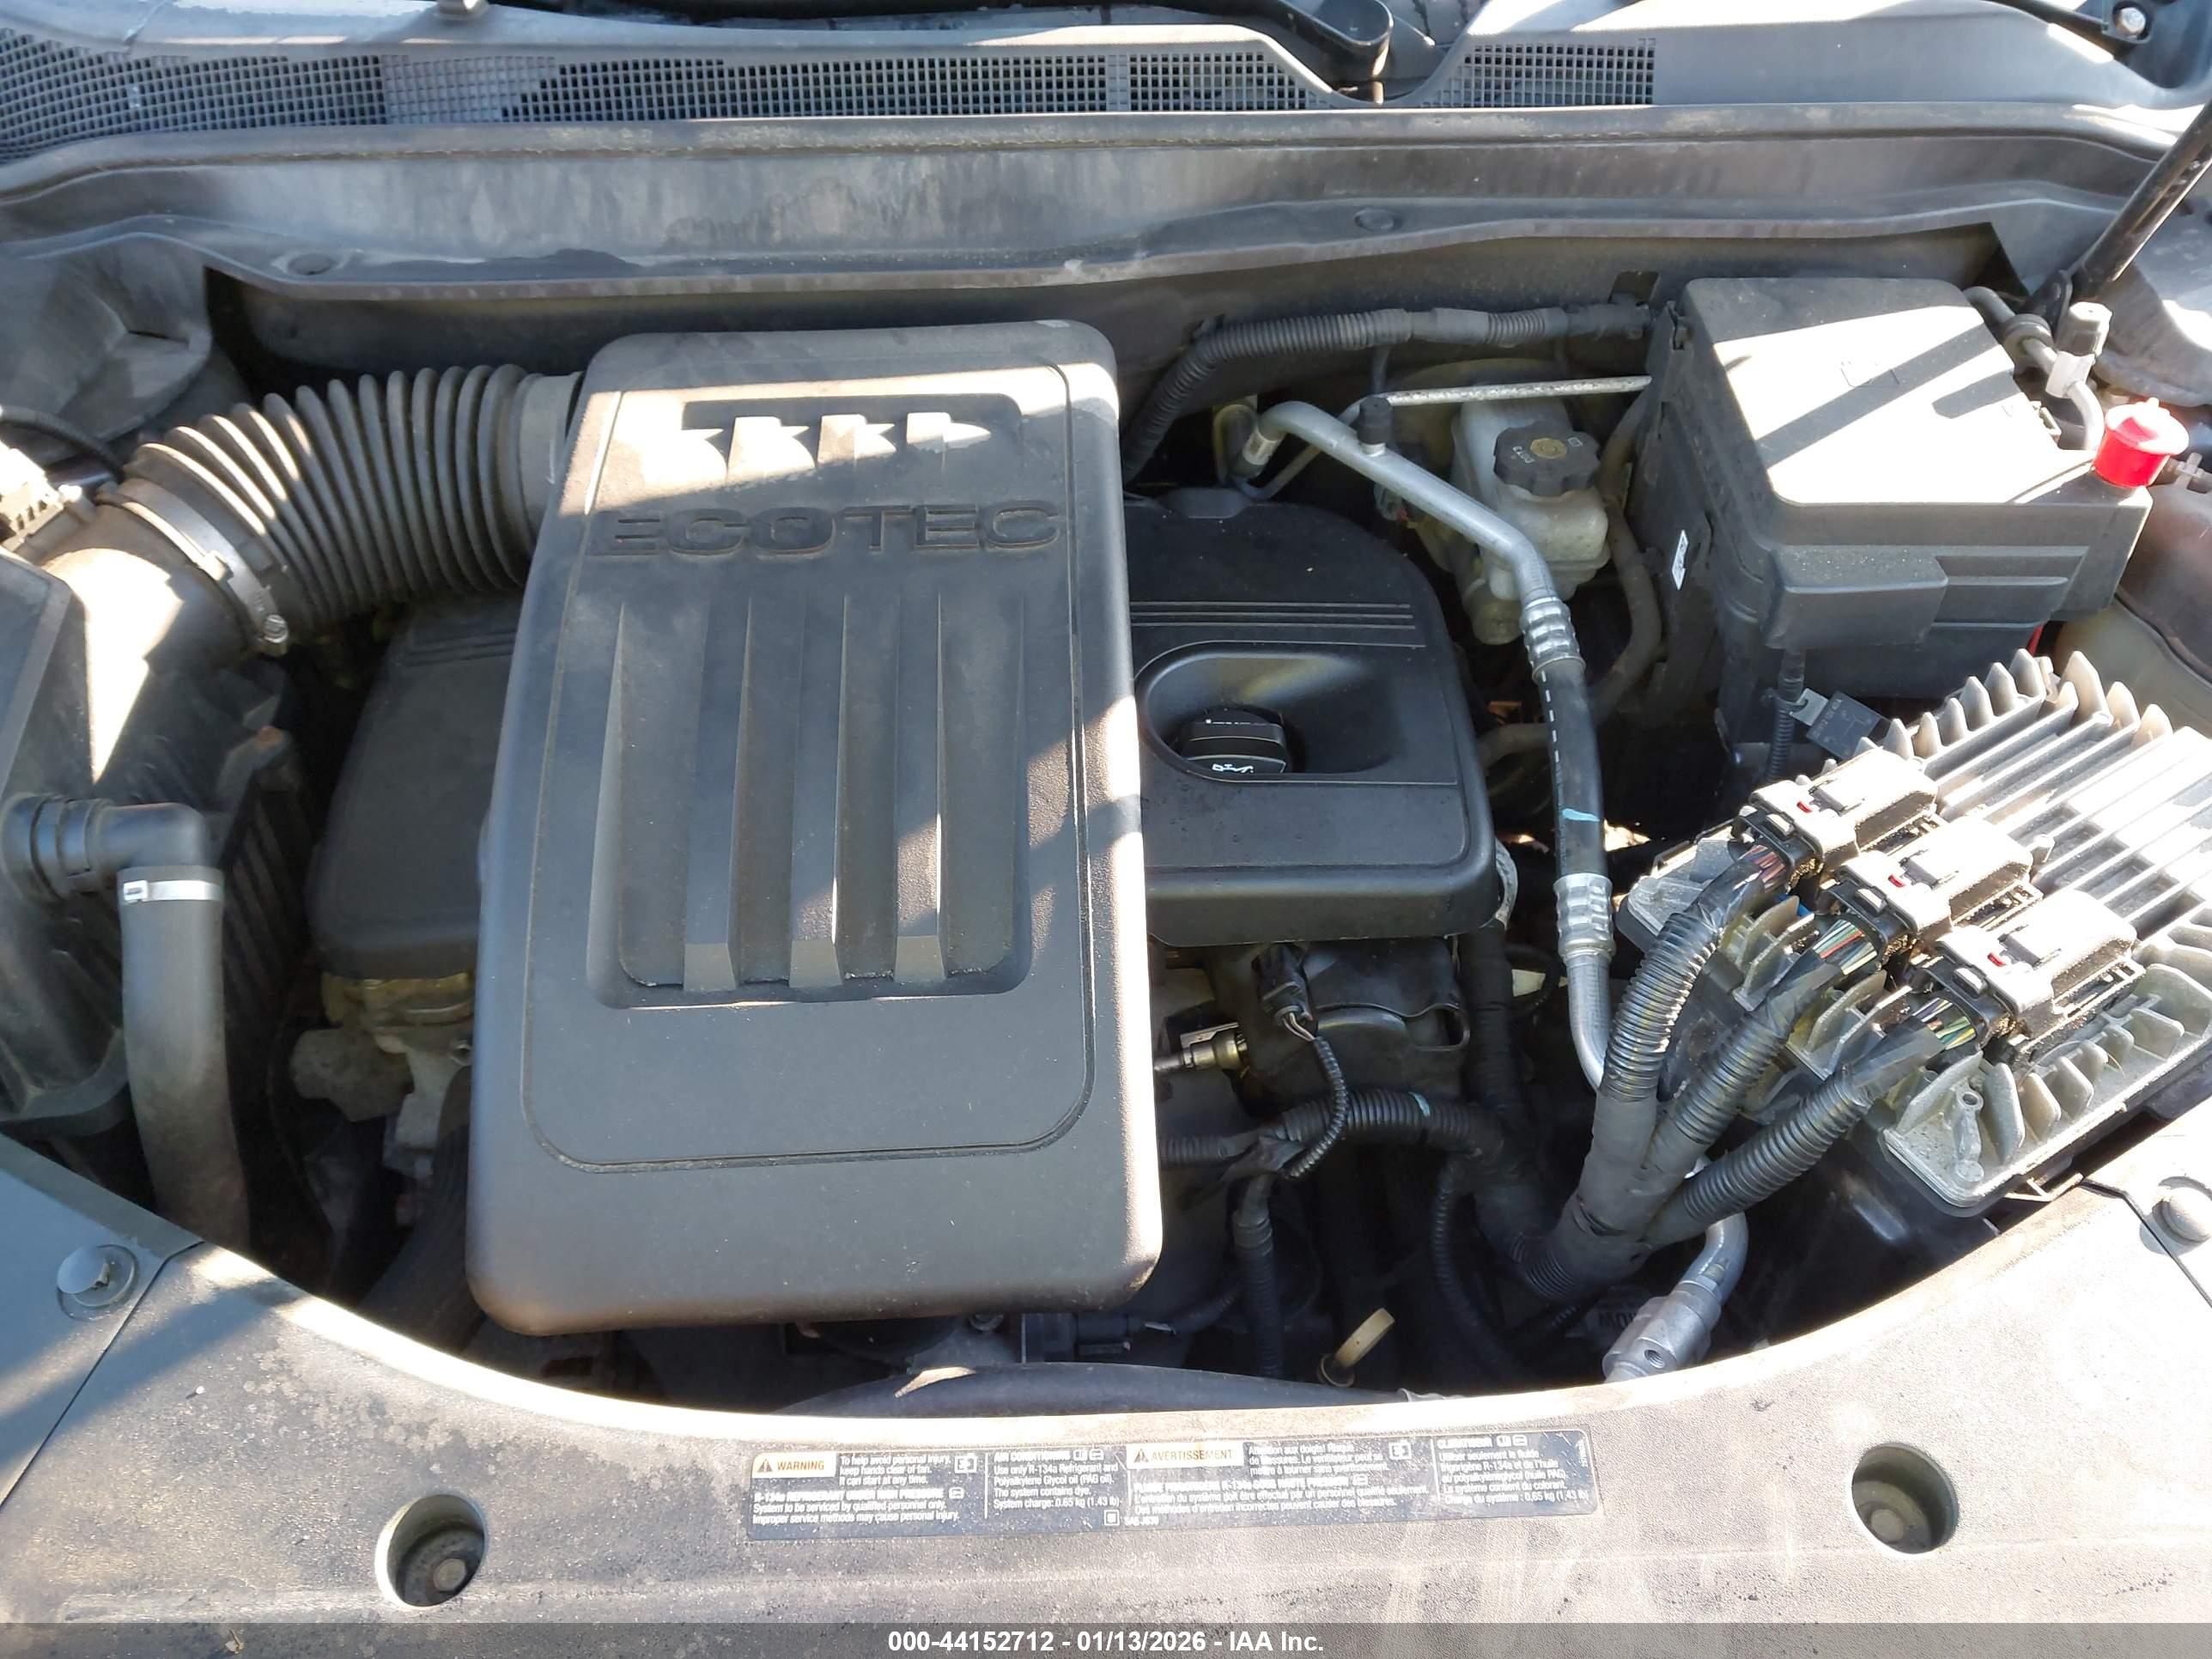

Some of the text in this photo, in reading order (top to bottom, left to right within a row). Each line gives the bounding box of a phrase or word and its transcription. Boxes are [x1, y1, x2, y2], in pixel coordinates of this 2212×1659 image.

[592, 501, 1058, 556] ECOTEC
[777, 1460, 824, 1471] WARNING
[840, 1456, 850, 1465] To
[852, 1456, 868, 1467] help
[870, 1455, 891, 1465] avoid
[892, 1455, 927, 1466] personal
[1483, 1461, 1513, 1471] R-134a
[840, 1464, 933, 1476] keep hands clear of fan.
[994, 1462, 1119, 1475] Use only R-134a Refrigerant and
[847, 1477, 861, 1486] can
[862, 1475, 881, 1486] start
[882, 1475, 891, 1485] at
[892, 1476, 908, 1486] any
[994, 1475, 1042, 1487] Polyalkylene
[1043, 1474, 1067, 1486] Glycol
[1069, 1474, 1078, 1485] oil
[1080, 1474, 1098, 1486] (PAG
[994, 1486, 1091, 1498] The system contains dye.
[1544, 1490, 1555, 1502] kg
[753, 1503, 784, 1514] System
[784, 1504, 793, 1512] to
[794, 1503, 805, 1511] be
[806, 1502, 841, 1513] serviced
[842, 1502, 852, 1512] by
[888, 1500, 927, 1511] personnel
[994, 1498, 1023, 1510] System
[1075, 1497, 1086, 1508] kg
[1087, 1496, 1108, 1508] (1.43
[752, 1510, 960, 1526] Improper service methods may cause personal injury.
